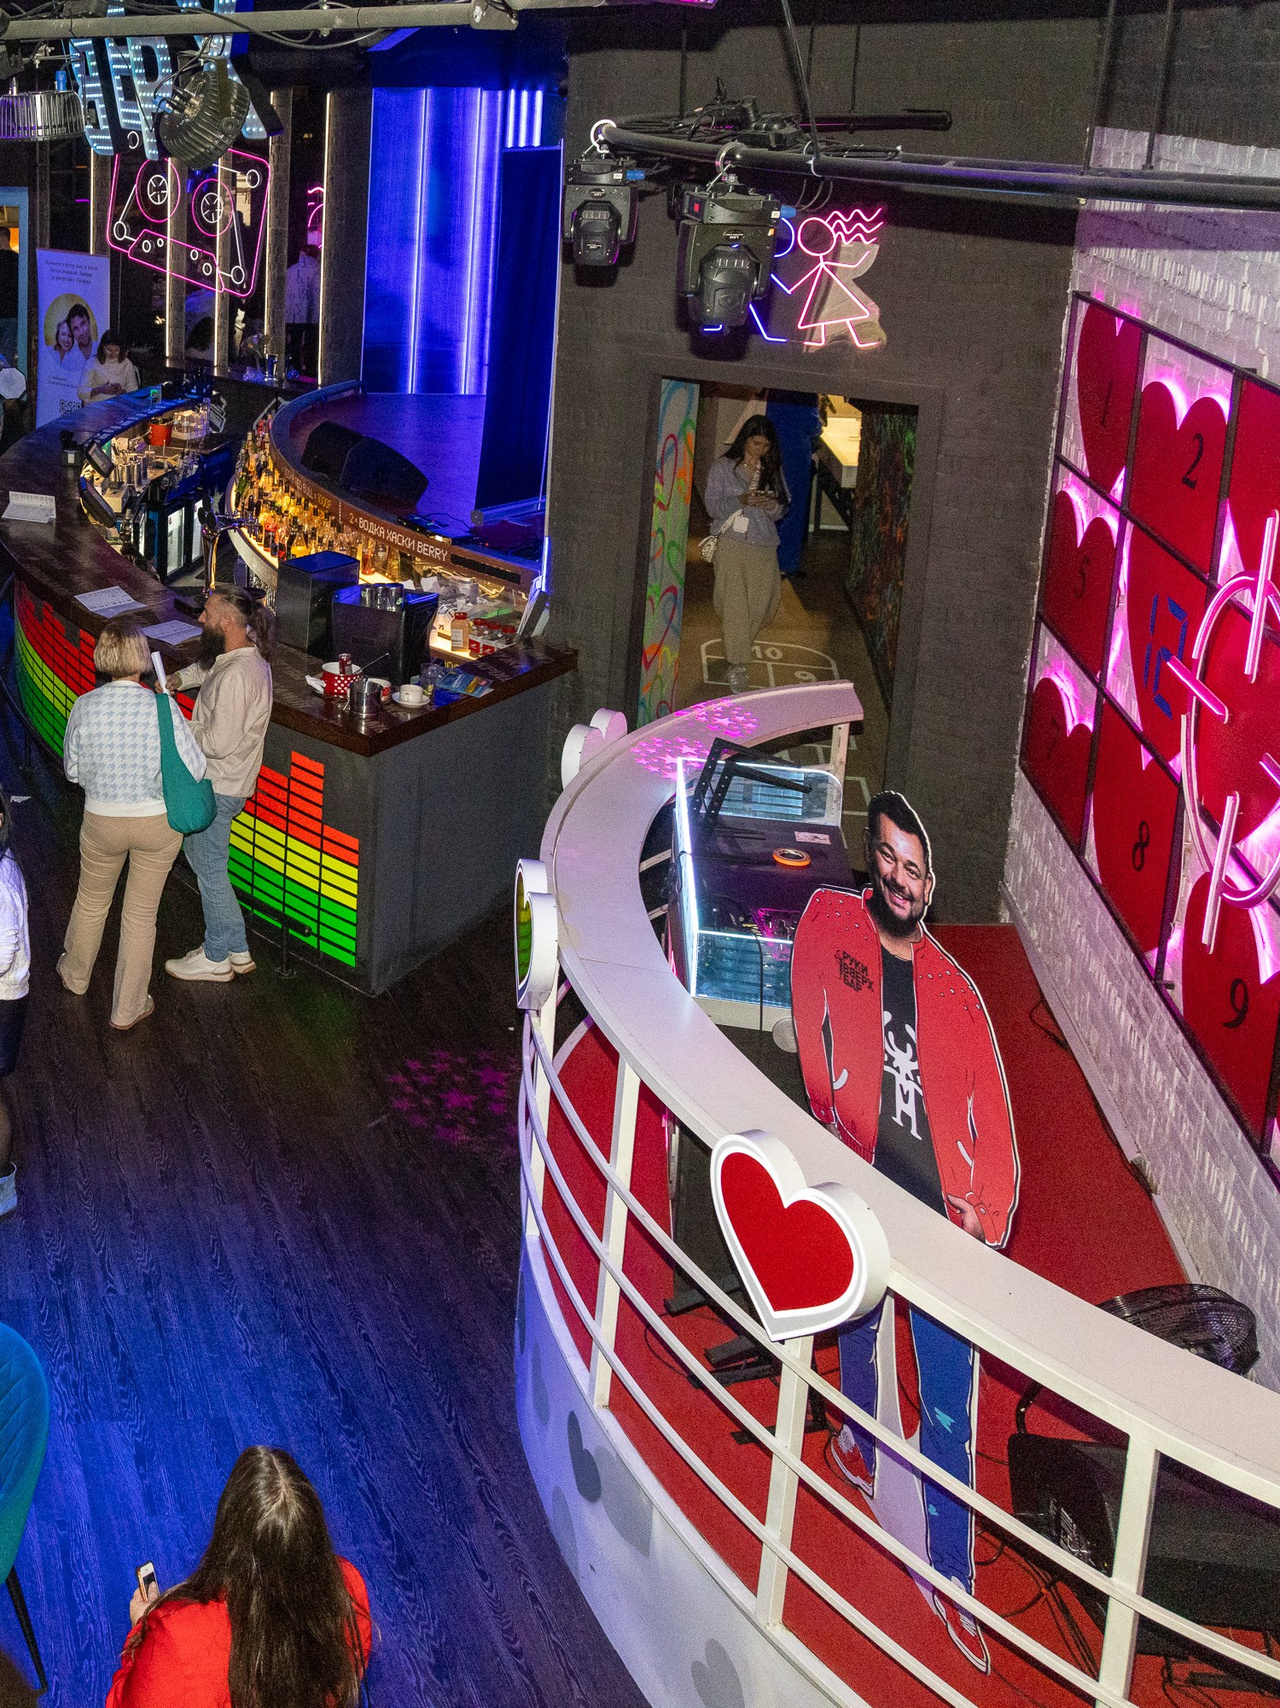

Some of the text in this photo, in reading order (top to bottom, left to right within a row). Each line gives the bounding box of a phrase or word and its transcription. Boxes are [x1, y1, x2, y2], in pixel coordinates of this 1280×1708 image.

[1182, 433, 1204, 489] 2
[358, 516, 385, 539] ВОДКА
[386, 530, 416, 551] ХАСКИ
[417, 541, 448, 562] BERRY
[751, 645, 783, 660] 10
[1132, 821, 1150, 872] 8
[842, 950, 868, 977] РУКИ
[843, 973, 862, 992] БАР
[1223, 978, 1250, 1029] 9
